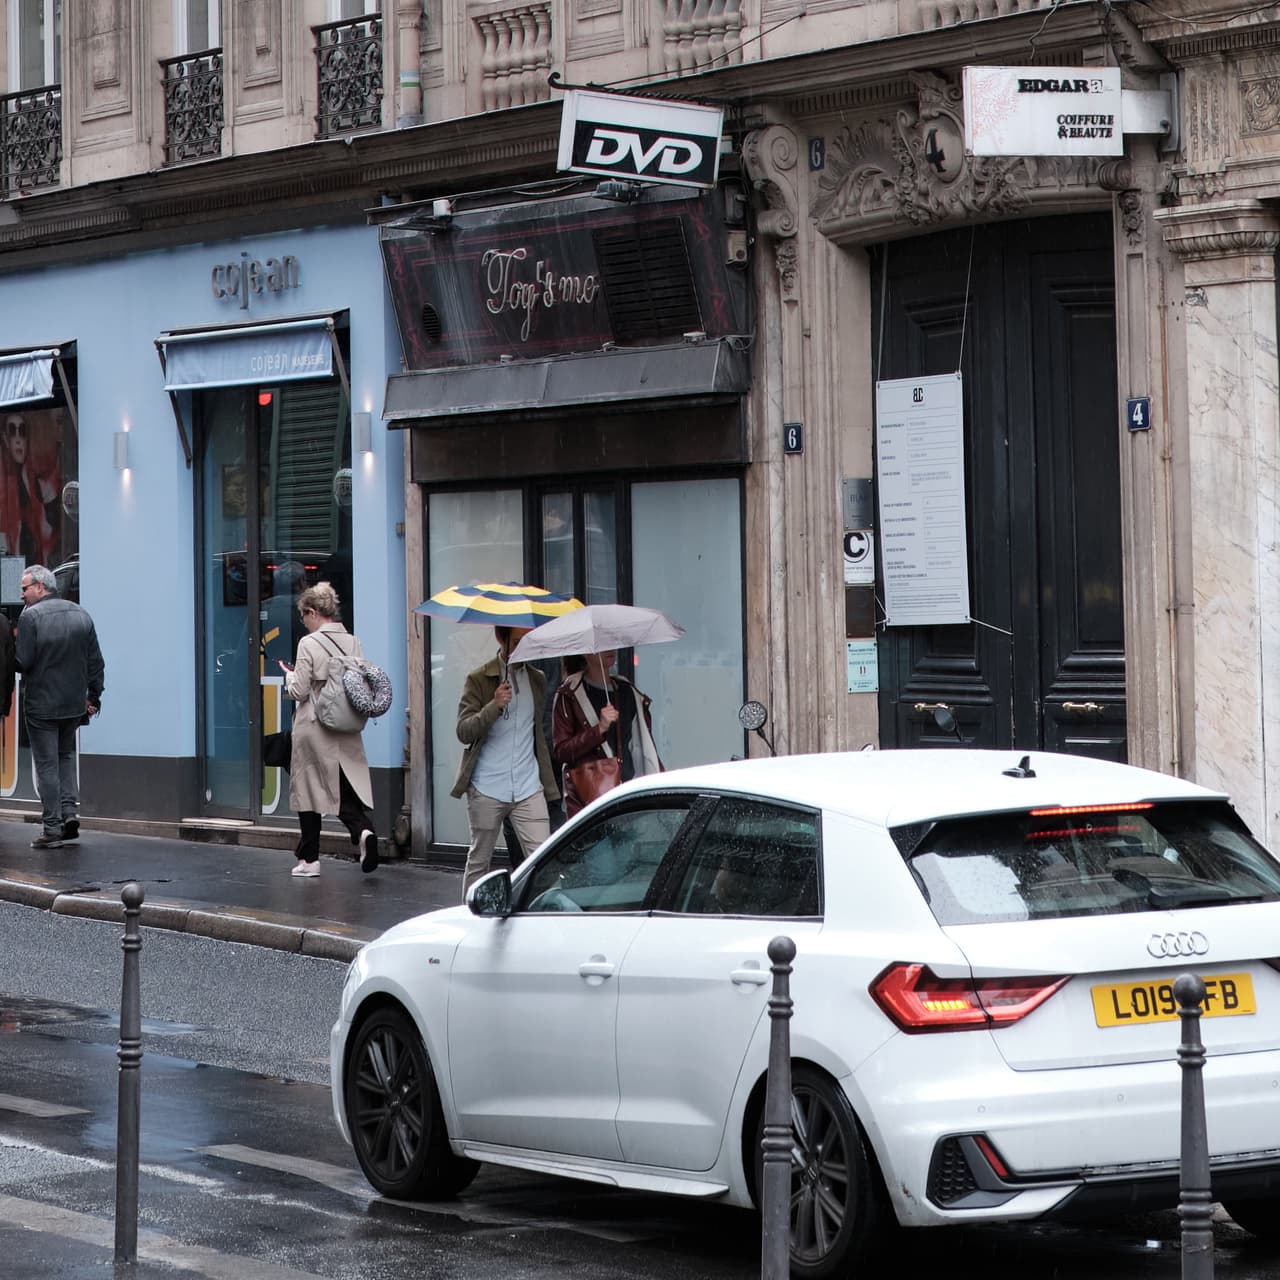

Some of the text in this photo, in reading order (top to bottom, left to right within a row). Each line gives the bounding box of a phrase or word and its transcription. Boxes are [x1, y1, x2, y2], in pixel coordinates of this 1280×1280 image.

[1017, 78, 1090, 93] EDGAR
[1057, 114, 1115, 125] COIFFURE
[584, 128, 703, 175] DVD
[925, 128, 947, 173] 4
[211, 251, 299, 310] cojean
[1132, 402, 1144, 425] 4
[788, 428, 797, 449] 6
